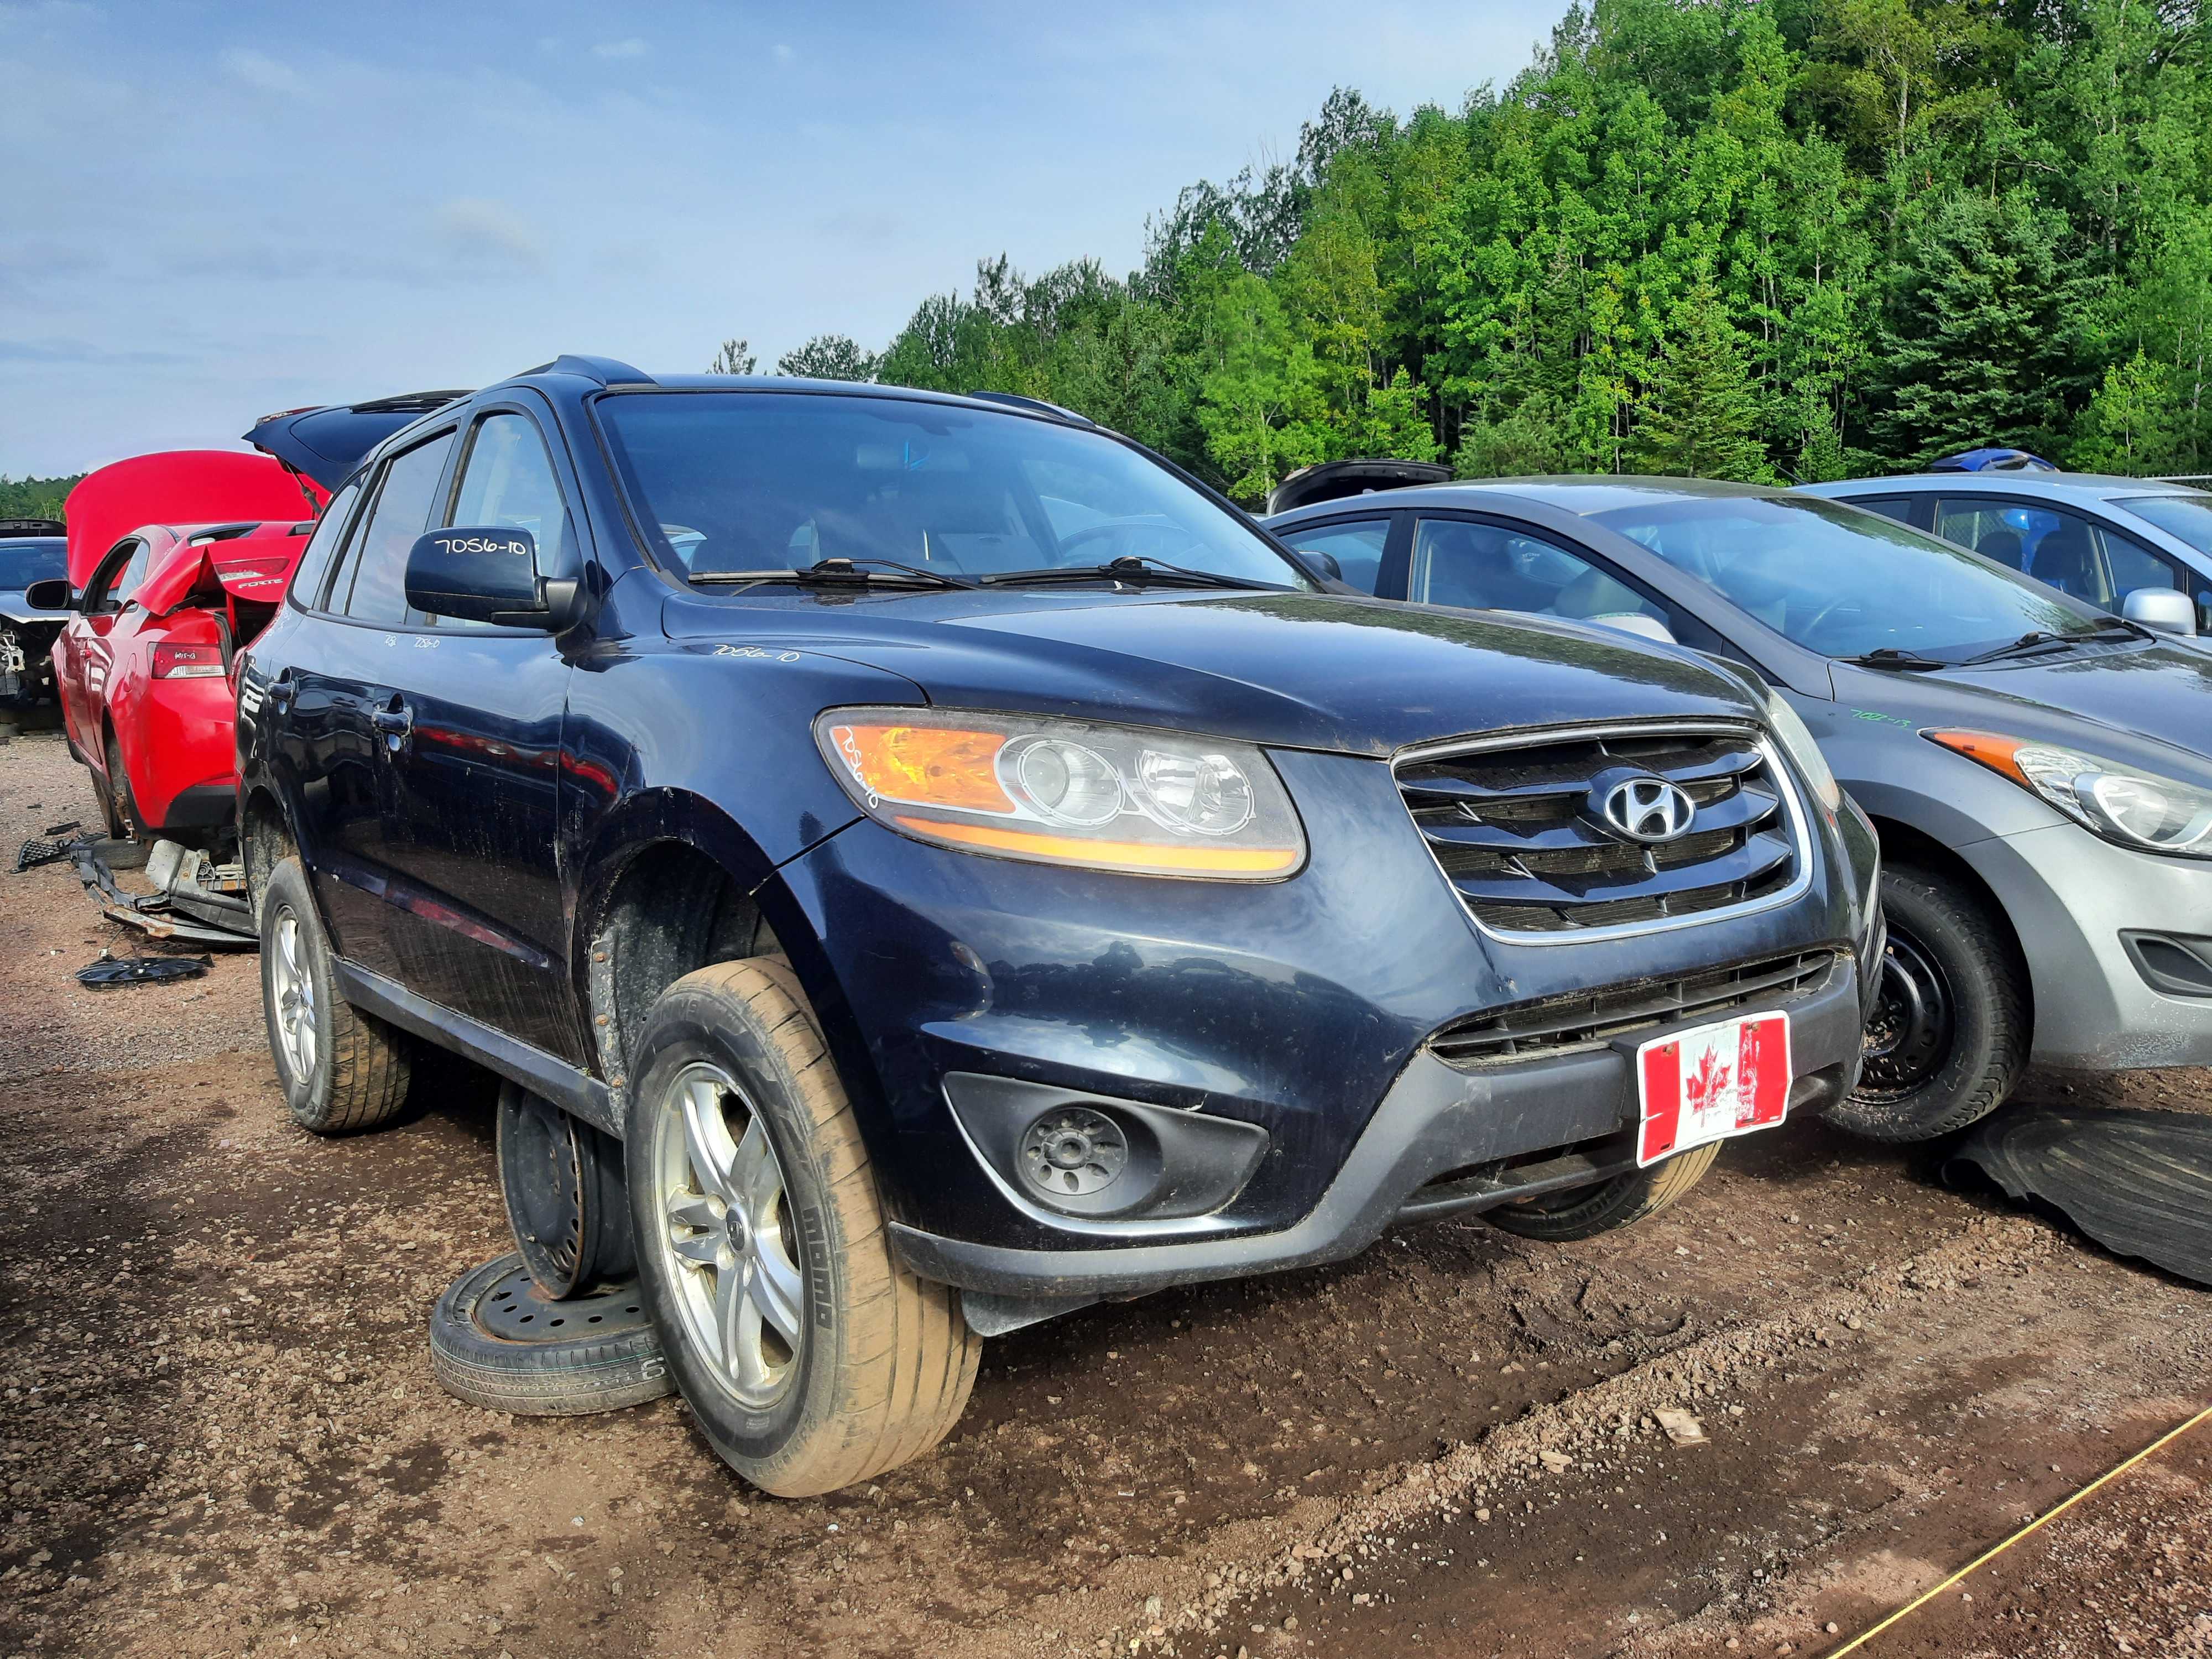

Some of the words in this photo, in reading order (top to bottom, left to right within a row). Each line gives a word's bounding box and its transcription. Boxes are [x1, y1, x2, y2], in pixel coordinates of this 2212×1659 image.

[435, 538, 526, 555] 7056-10
[238, 578, 284, 589] FORTE
[712, 644, 801, 662] 7056-10
